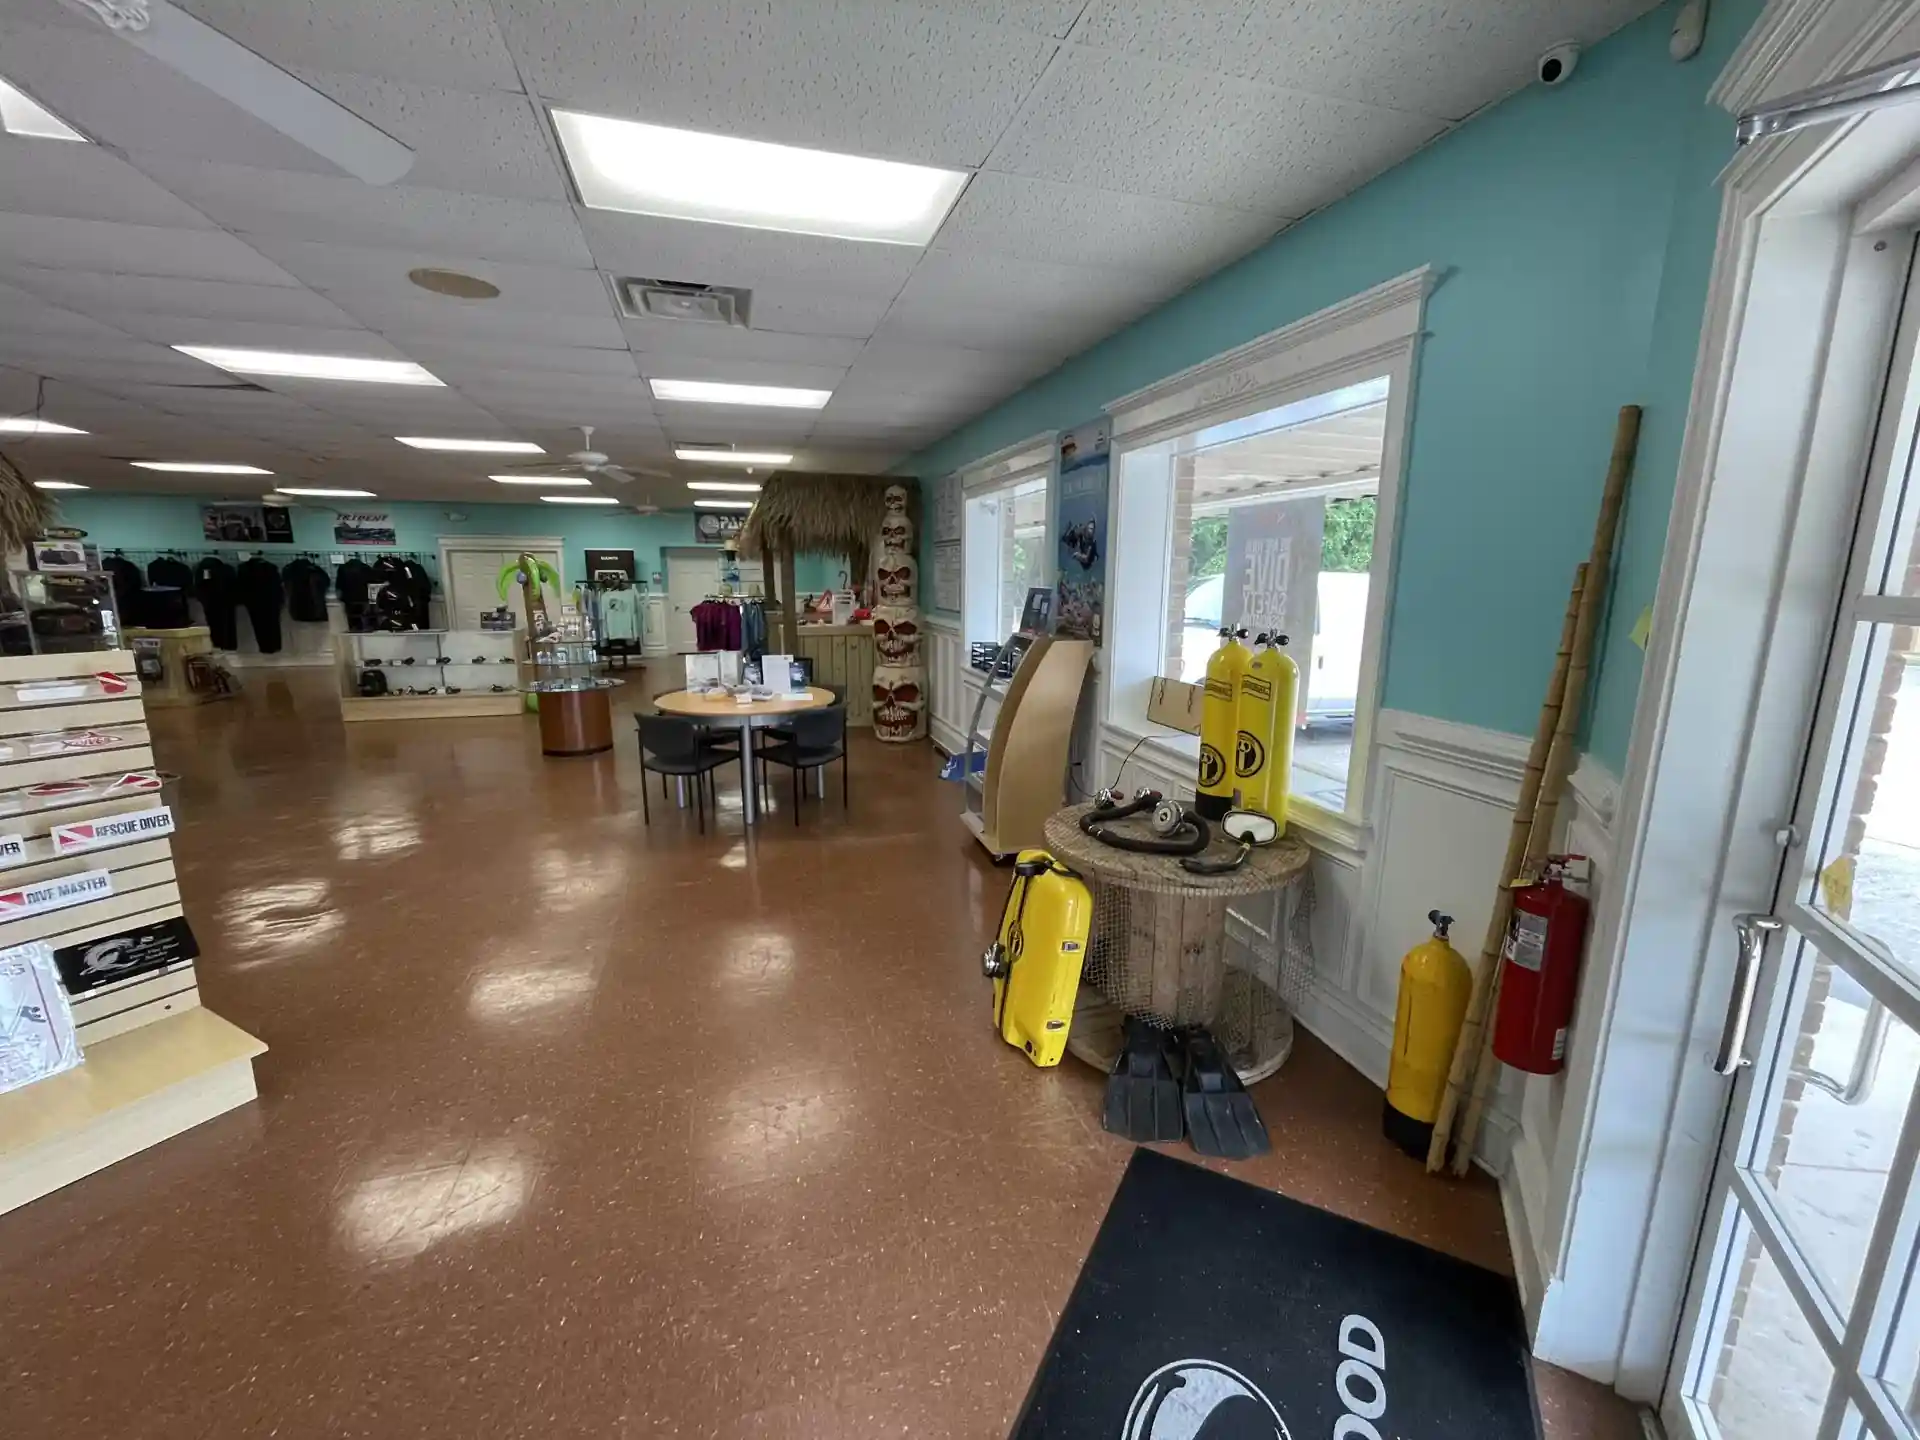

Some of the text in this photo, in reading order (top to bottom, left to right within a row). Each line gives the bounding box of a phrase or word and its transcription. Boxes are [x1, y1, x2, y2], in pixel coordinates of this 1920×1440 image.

[95, 814, 171, 837] RESCUE DIVER
[26, 876, 108, 905] DIVE MASTER
